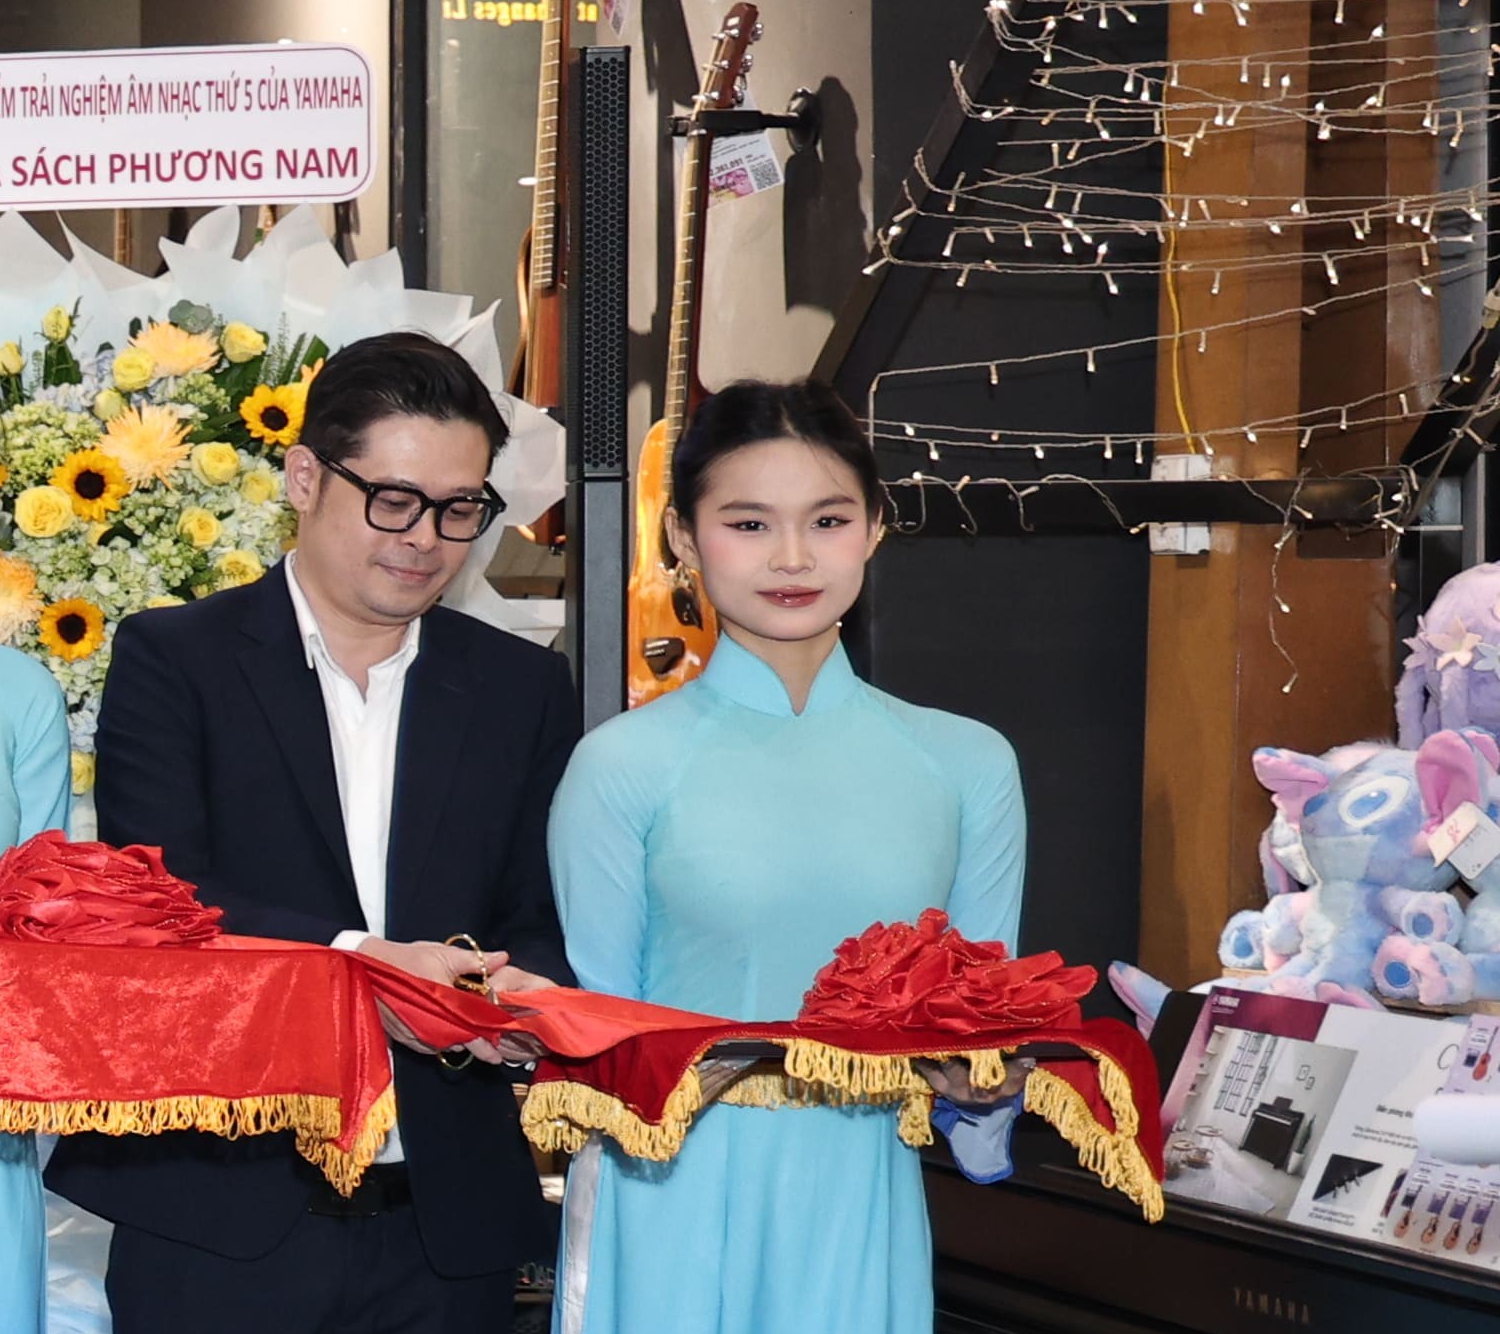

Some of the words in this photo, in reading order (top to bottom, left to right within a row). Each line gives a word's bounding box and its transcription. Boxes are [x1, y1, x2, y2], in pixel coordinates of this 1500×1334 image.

[20, 72, 53, 117] TRẢI
[58, 74, 122, 123] NGHIỆM
[126, 75, 154, 115] ÂM
[158, 80, 201, 123] NHẠC
[205, 70, 241, 114] THỨ
[243, 78, 254, 113] 5
[257, 66, 290, 112] CỦA
[293, 76, 363, 110] YAMAHA
[12, 147, 97, 187] SÁCH
[109, 148, 264, 184] PHƯƠNG
[275, 146, 360, 179] NAM
